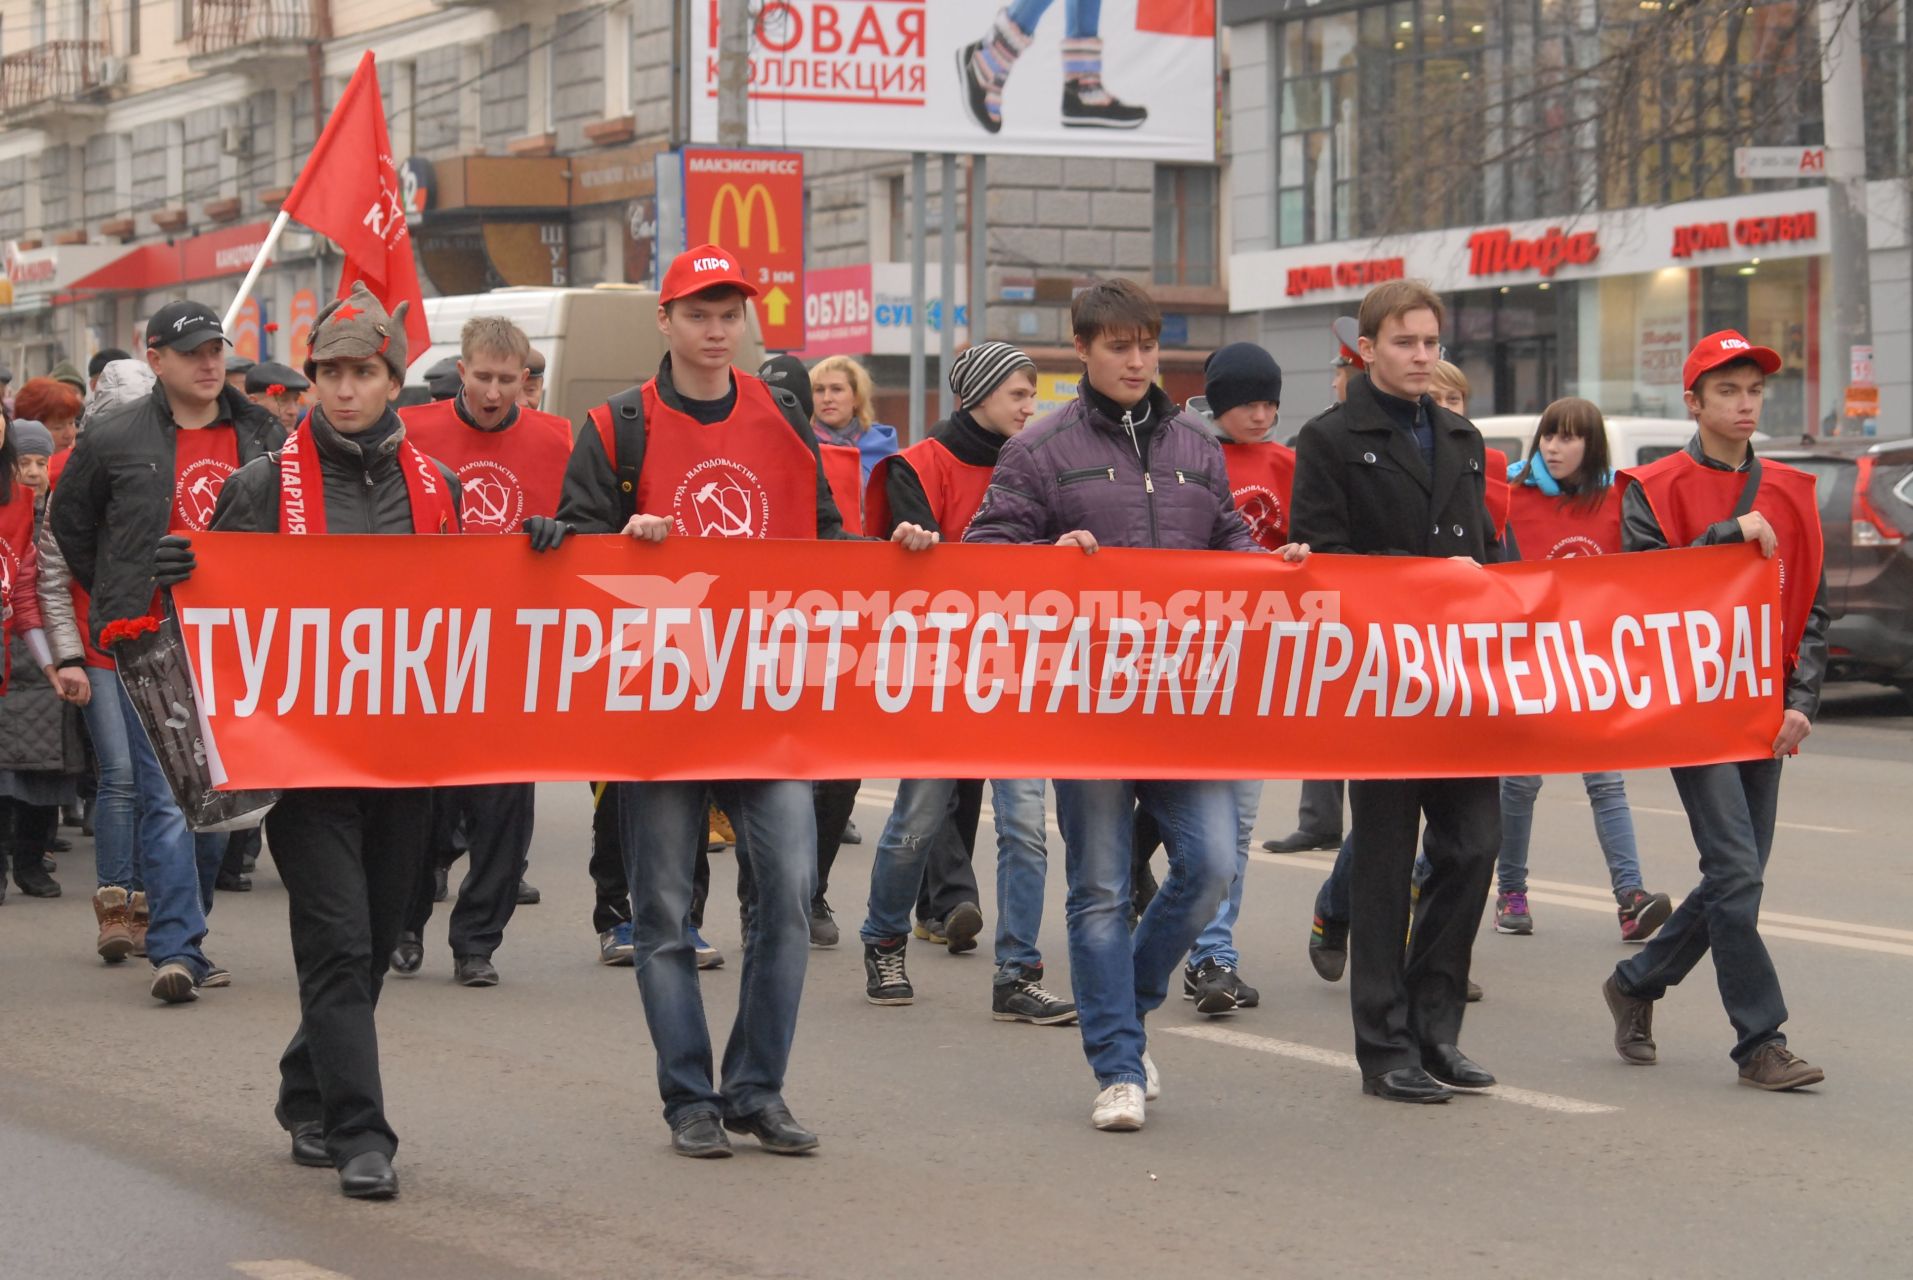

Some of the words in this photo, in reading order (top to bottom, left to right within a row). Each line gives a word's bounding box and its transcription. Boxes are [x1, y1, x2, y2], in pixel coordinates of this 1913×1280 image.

[690, 158, 798, 174] МАКЭКСПРЕСС
[1467, 227, 1598, 276] Тофа
[1672, 222, 1730, 258] ДОМ
[1735, 211, 1817, 246] ОБУВИ
[693, 257, 730, 273] КПРФ
[758, 267, 769, 283] 3
[1286, 265, 1334, 296] ДОМ
[1337, 256, 1405, 286] ОБУВИ
[805, 288, 870, 326] ОБУВЬ
[686, 458, 758, 483] НАРОДОВЛАСТИЕ
[281, 461, 306, 534] ПАРТИЯ
[183, 607, 492, 716] ТУЛЯКИ
[515, 608, 860, 713] ТРЕБУЮТ
[872, 611, 1240, 717] ОТСТАВКИ
[1256, 603, 1773, 718] ПРАВИТЕЛЬСТВА!
